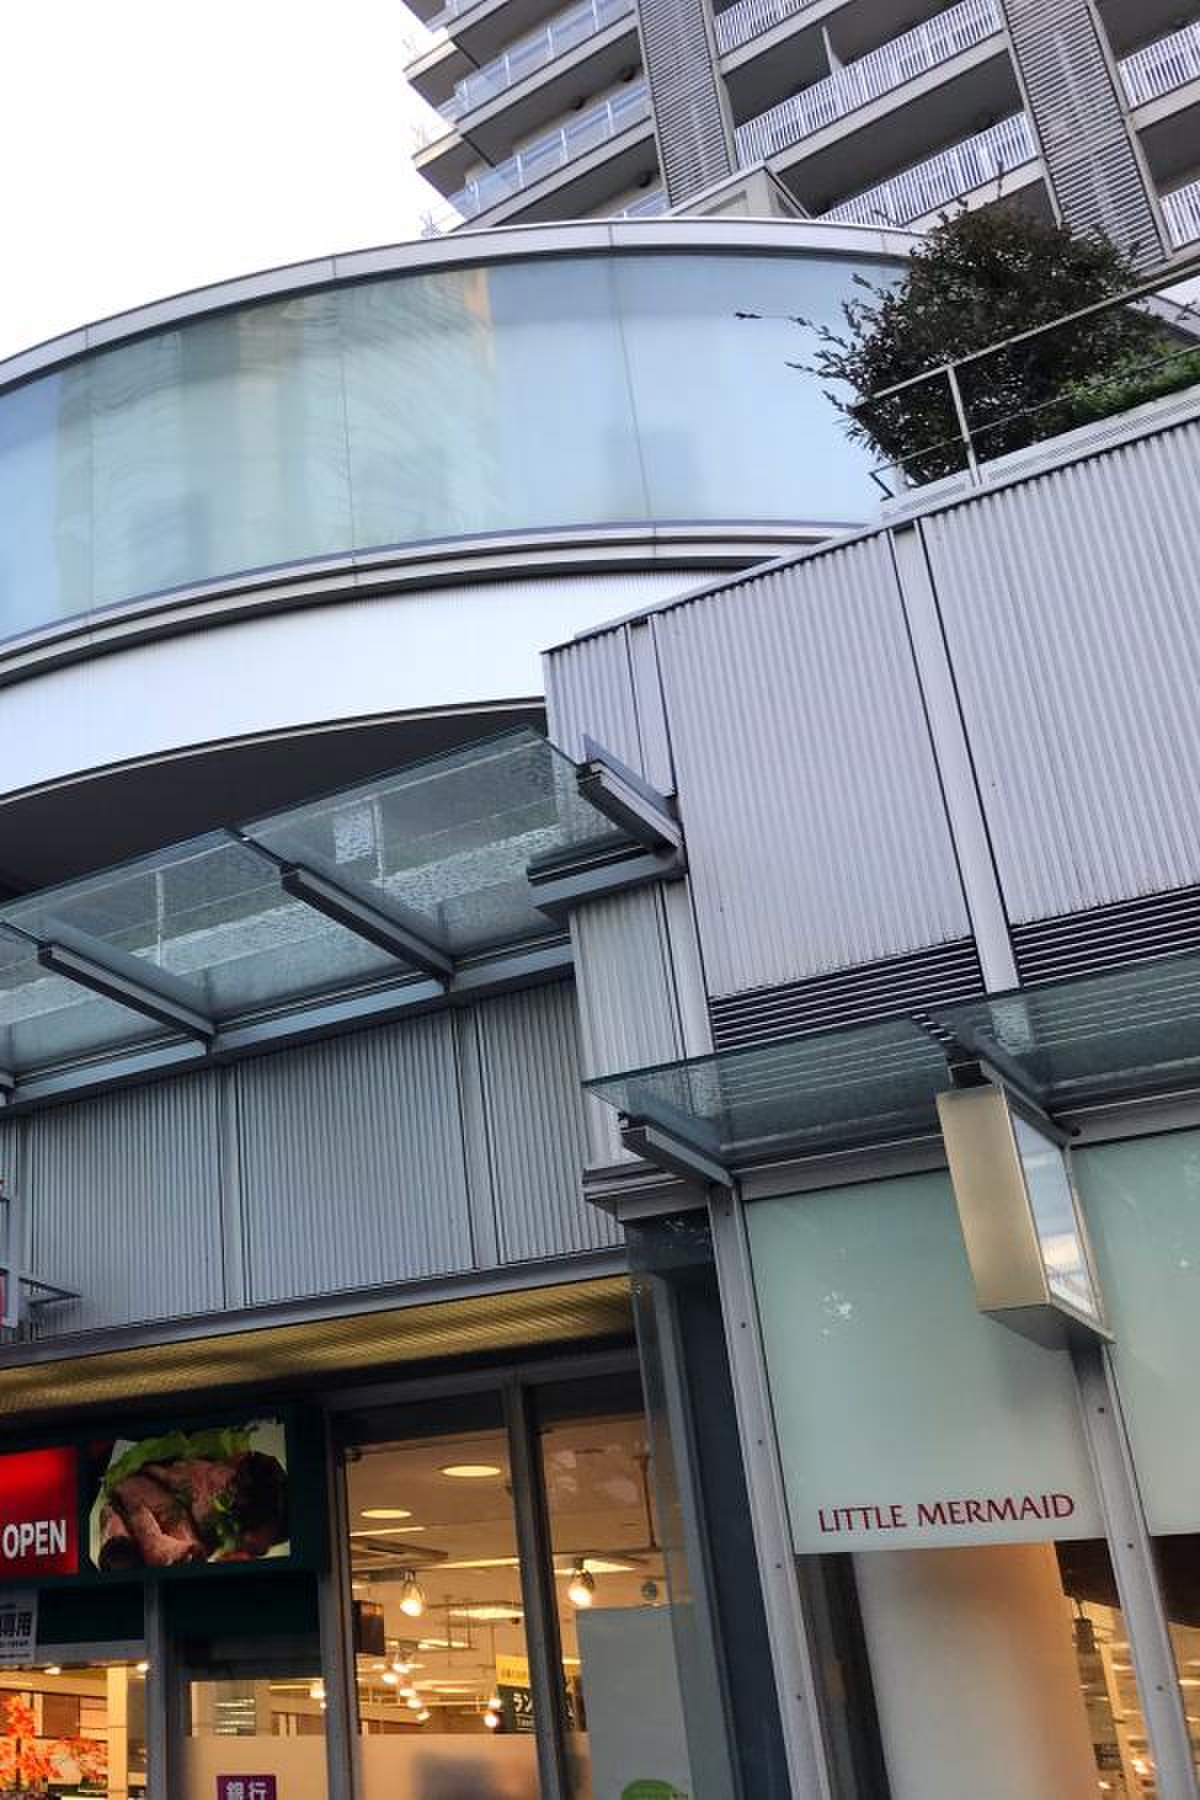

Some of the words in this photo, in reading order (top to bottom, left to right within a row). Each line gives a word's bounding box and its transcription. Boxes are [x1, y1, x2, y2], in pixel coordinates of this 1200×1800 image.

[818, 1504, 907, 1533] LITTLE
[917, 1493, 1075, 1527] MERMAID
[2, 1519, 67, 1560] OPEN
